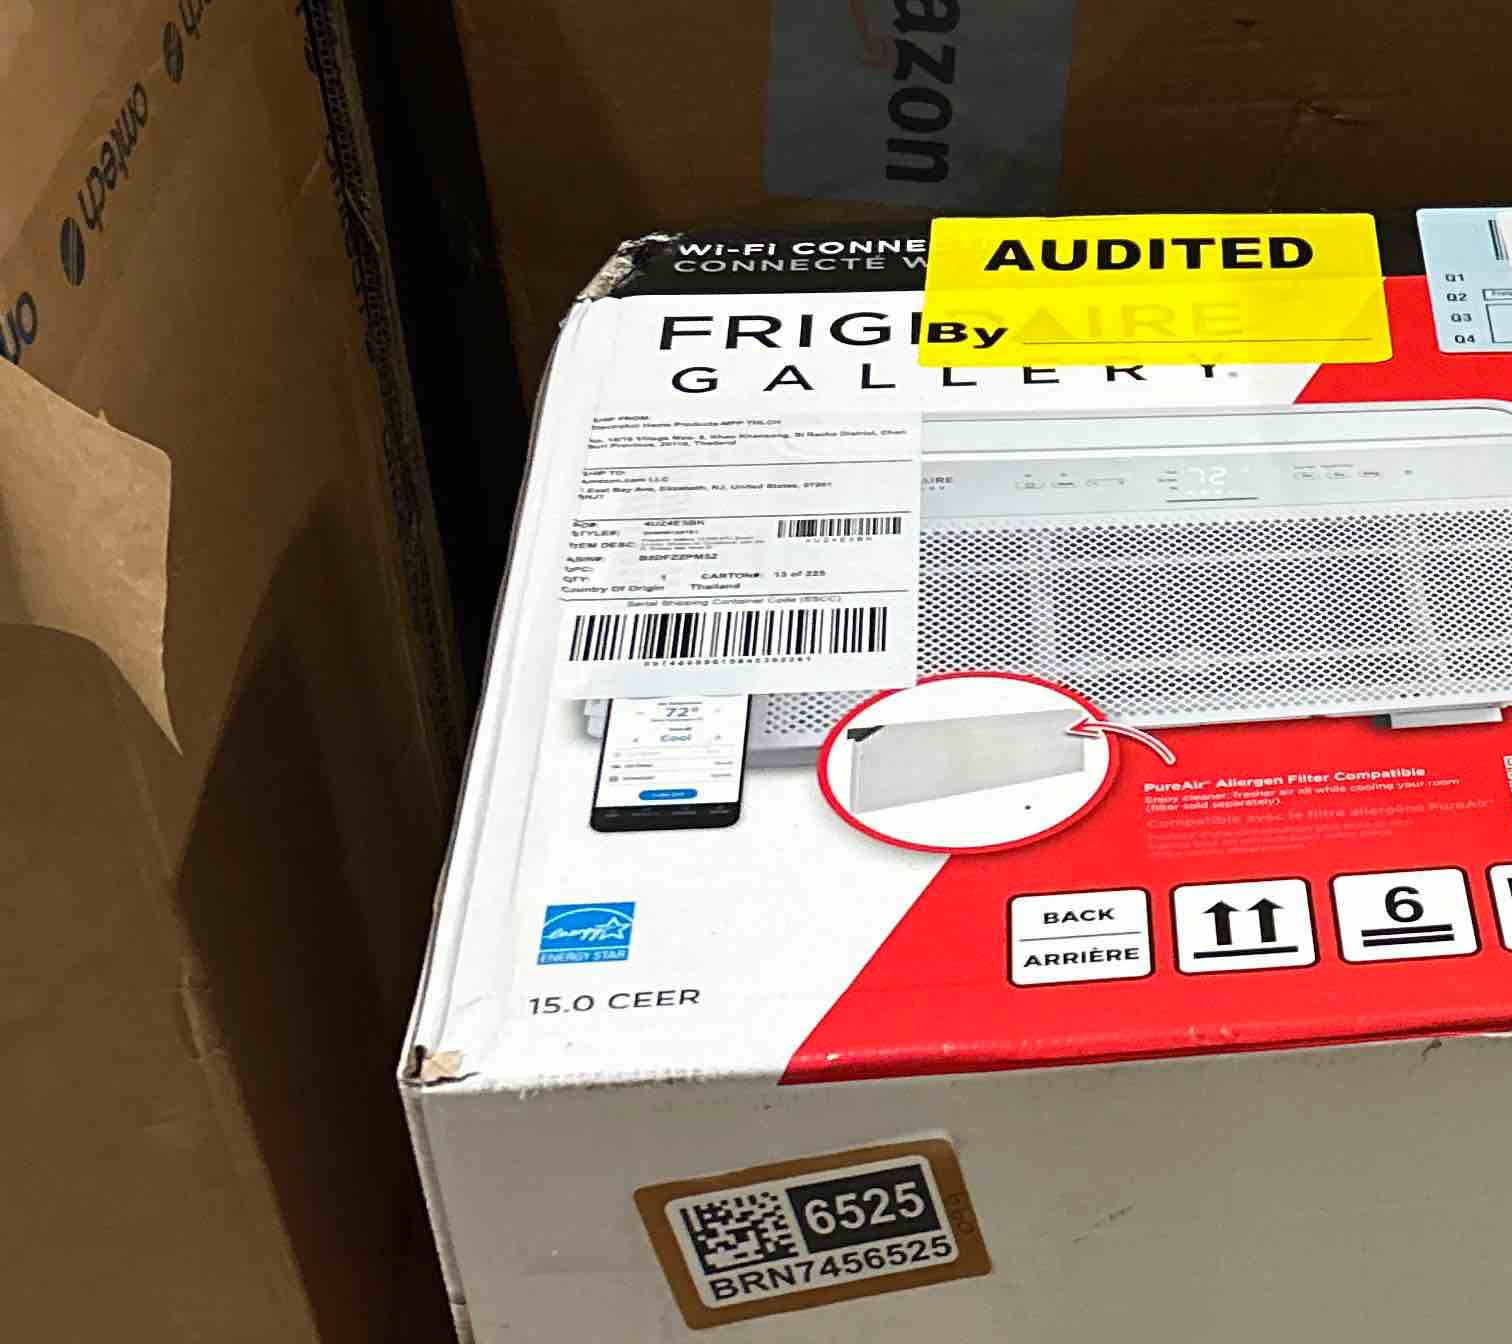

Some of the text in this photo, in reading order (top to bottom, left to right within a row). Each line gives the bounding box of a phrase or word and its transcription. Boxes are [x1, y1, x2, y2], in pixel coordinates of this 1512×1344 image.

[76, 82, 150, 233] omtech
[679, 239, 926, 257] Wi-Fi CONNE
[984, 236, 1314, 272] AUDITED
[673, 256, 886, 273] CONNECTÉ
[1445, 272, 1465, 283] Q1
[1446, 293, 1468, 303] Q2
[1450, 312, 1473, 323] Q3
[926, 321, 1009, 349] By
[1454, 334, 1476, 344] Q4
[561, 585, 608, 594] Country
[690, 582, 742, 591] Thailand
[1215, 776, 1285, 789] Allergen
[1286, 772, 1330, 785] Filter
[1333, 767, 1427, 783] Compatible
[1384, 885, 1425, 923] 6
[1042, 907, 1116, 926] BACK
[540, 948, 629, 963] ENERGY STAR
[1023, 946, 1141, 969] ARRIÈRE
[528, 988, 701, 1017] 15.0 CEER
[804, 1180, 927, 1237] 6525
[708, 1234, 953, 1301] BRN7456525
